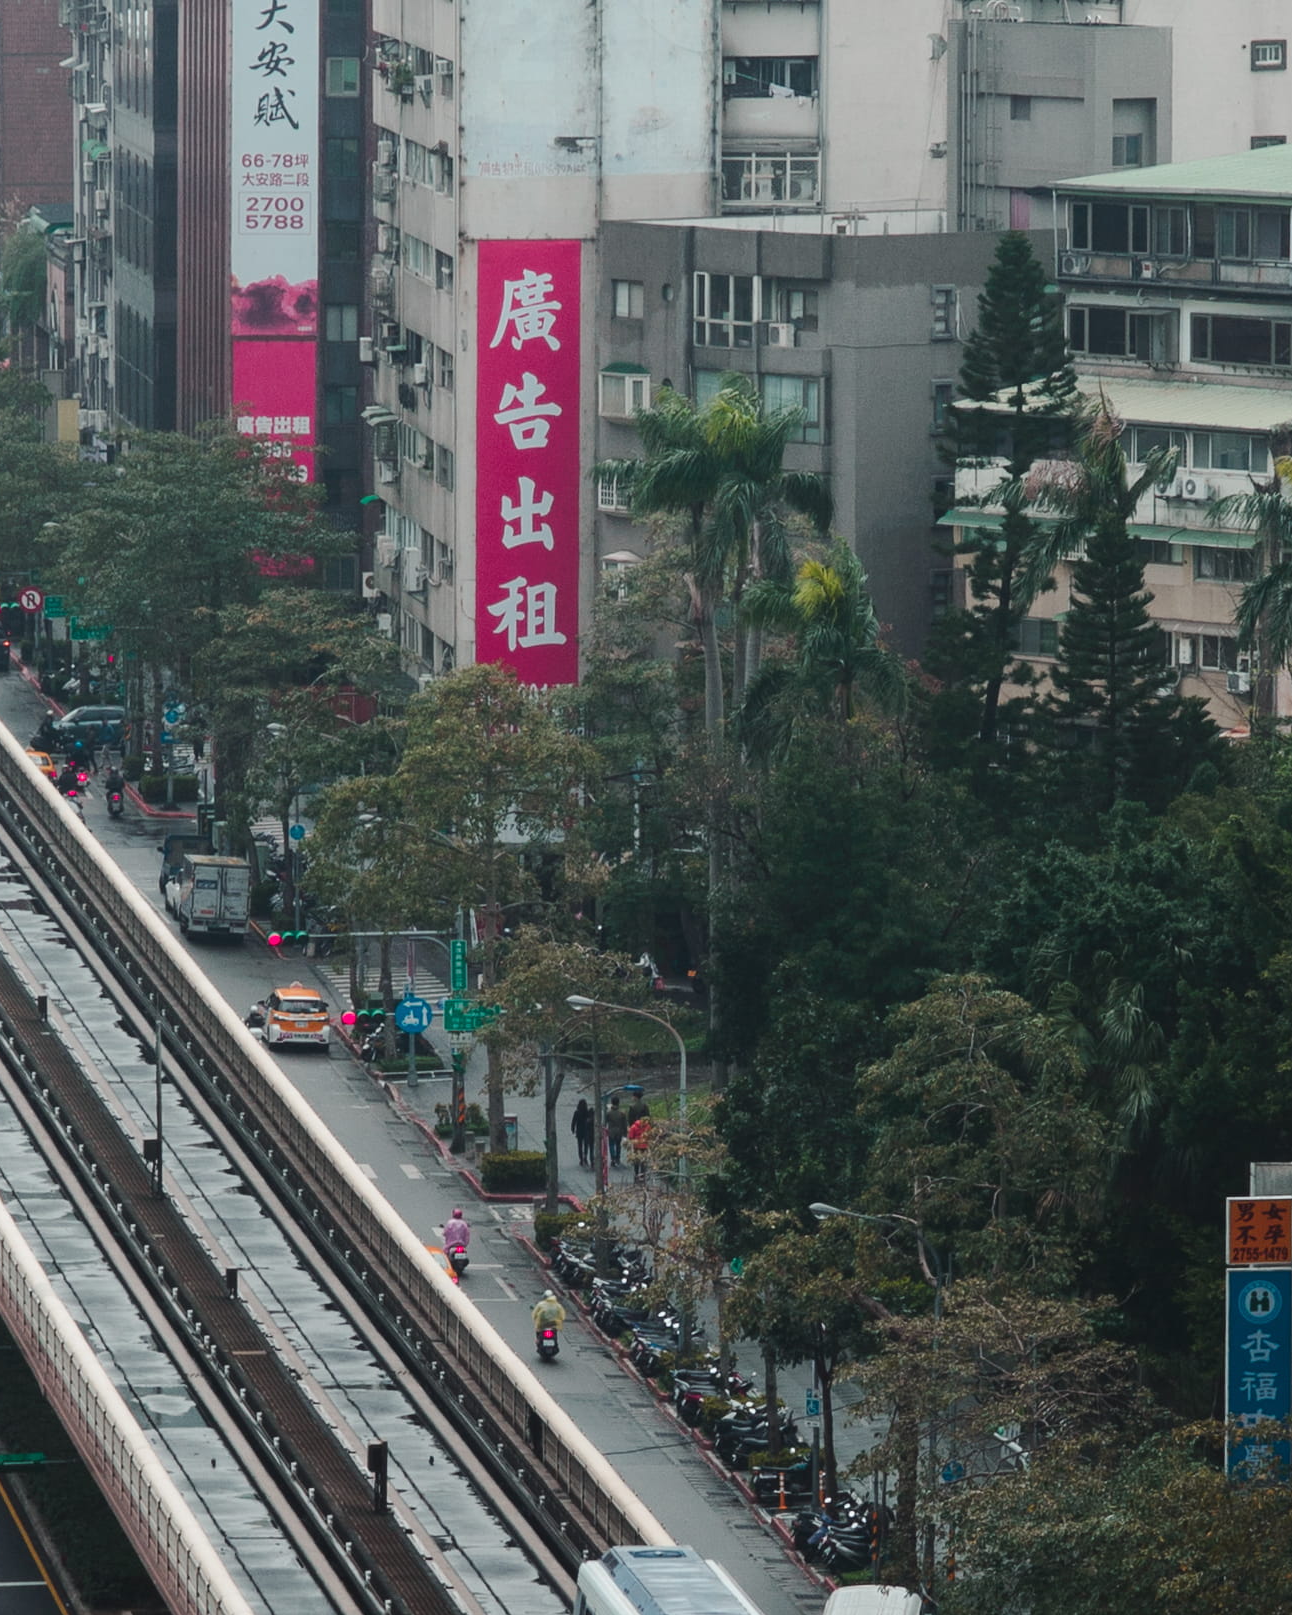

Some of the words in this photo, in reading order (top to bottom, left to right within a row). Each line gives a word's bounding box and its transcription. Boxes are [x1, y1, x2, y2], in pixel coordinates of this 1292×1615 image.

[241, 171, 310, 189] 大安路二段
[246, 195, 304, 213] 2700
[245, 213, 304, 231] 5788
[237, 415, 311, 435] 廣告出租
[486, 267, 568, 652] 廣告出租
